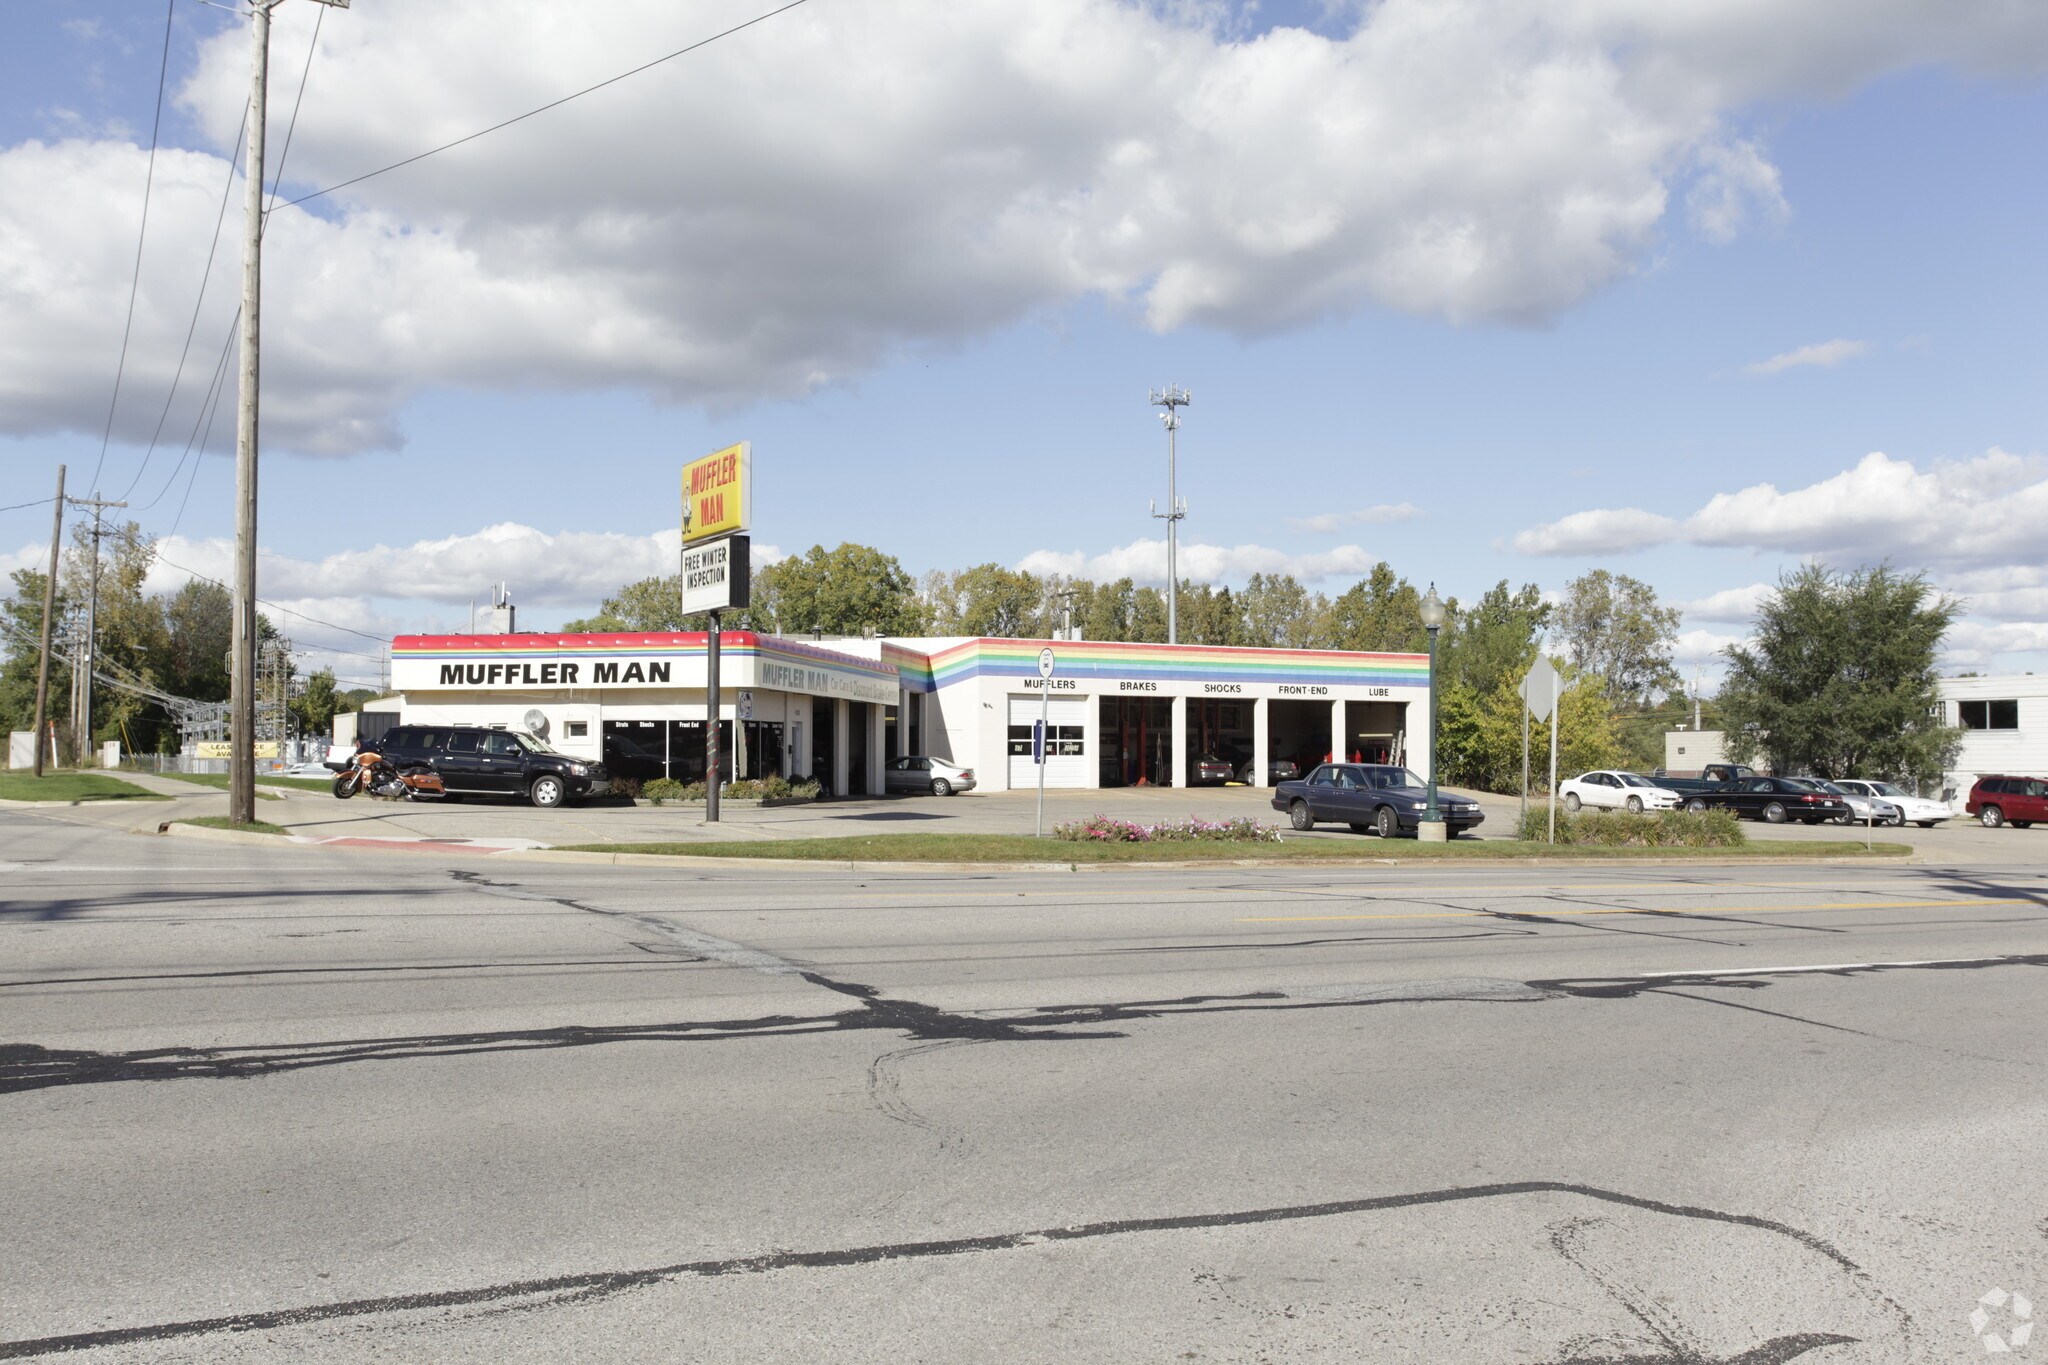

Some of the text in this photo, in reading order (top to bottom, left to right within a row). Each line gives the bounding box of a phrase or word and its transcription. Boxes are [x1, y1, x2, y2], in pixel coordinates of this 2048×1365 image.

[690, 453, 736, 496] MUFFLER
[700, 493, 724, 527] MAN
[684, 546, 727, 572] FREE WINTER
[687, 566, 725, 590] INSPECTION
[440, 662, 671, 685] MUFFLER MAN
[762, 662, 805, 689] MUFFLER
[807, 671, 829, 692] MAN
[1120, 682, 1157, 691] BRAKES
[1204, 684, 1241, 693] SHOCKS
[1278, 685, 1328, 695] FRONT-END
[1369, 688, 1389, 697] LUBE
